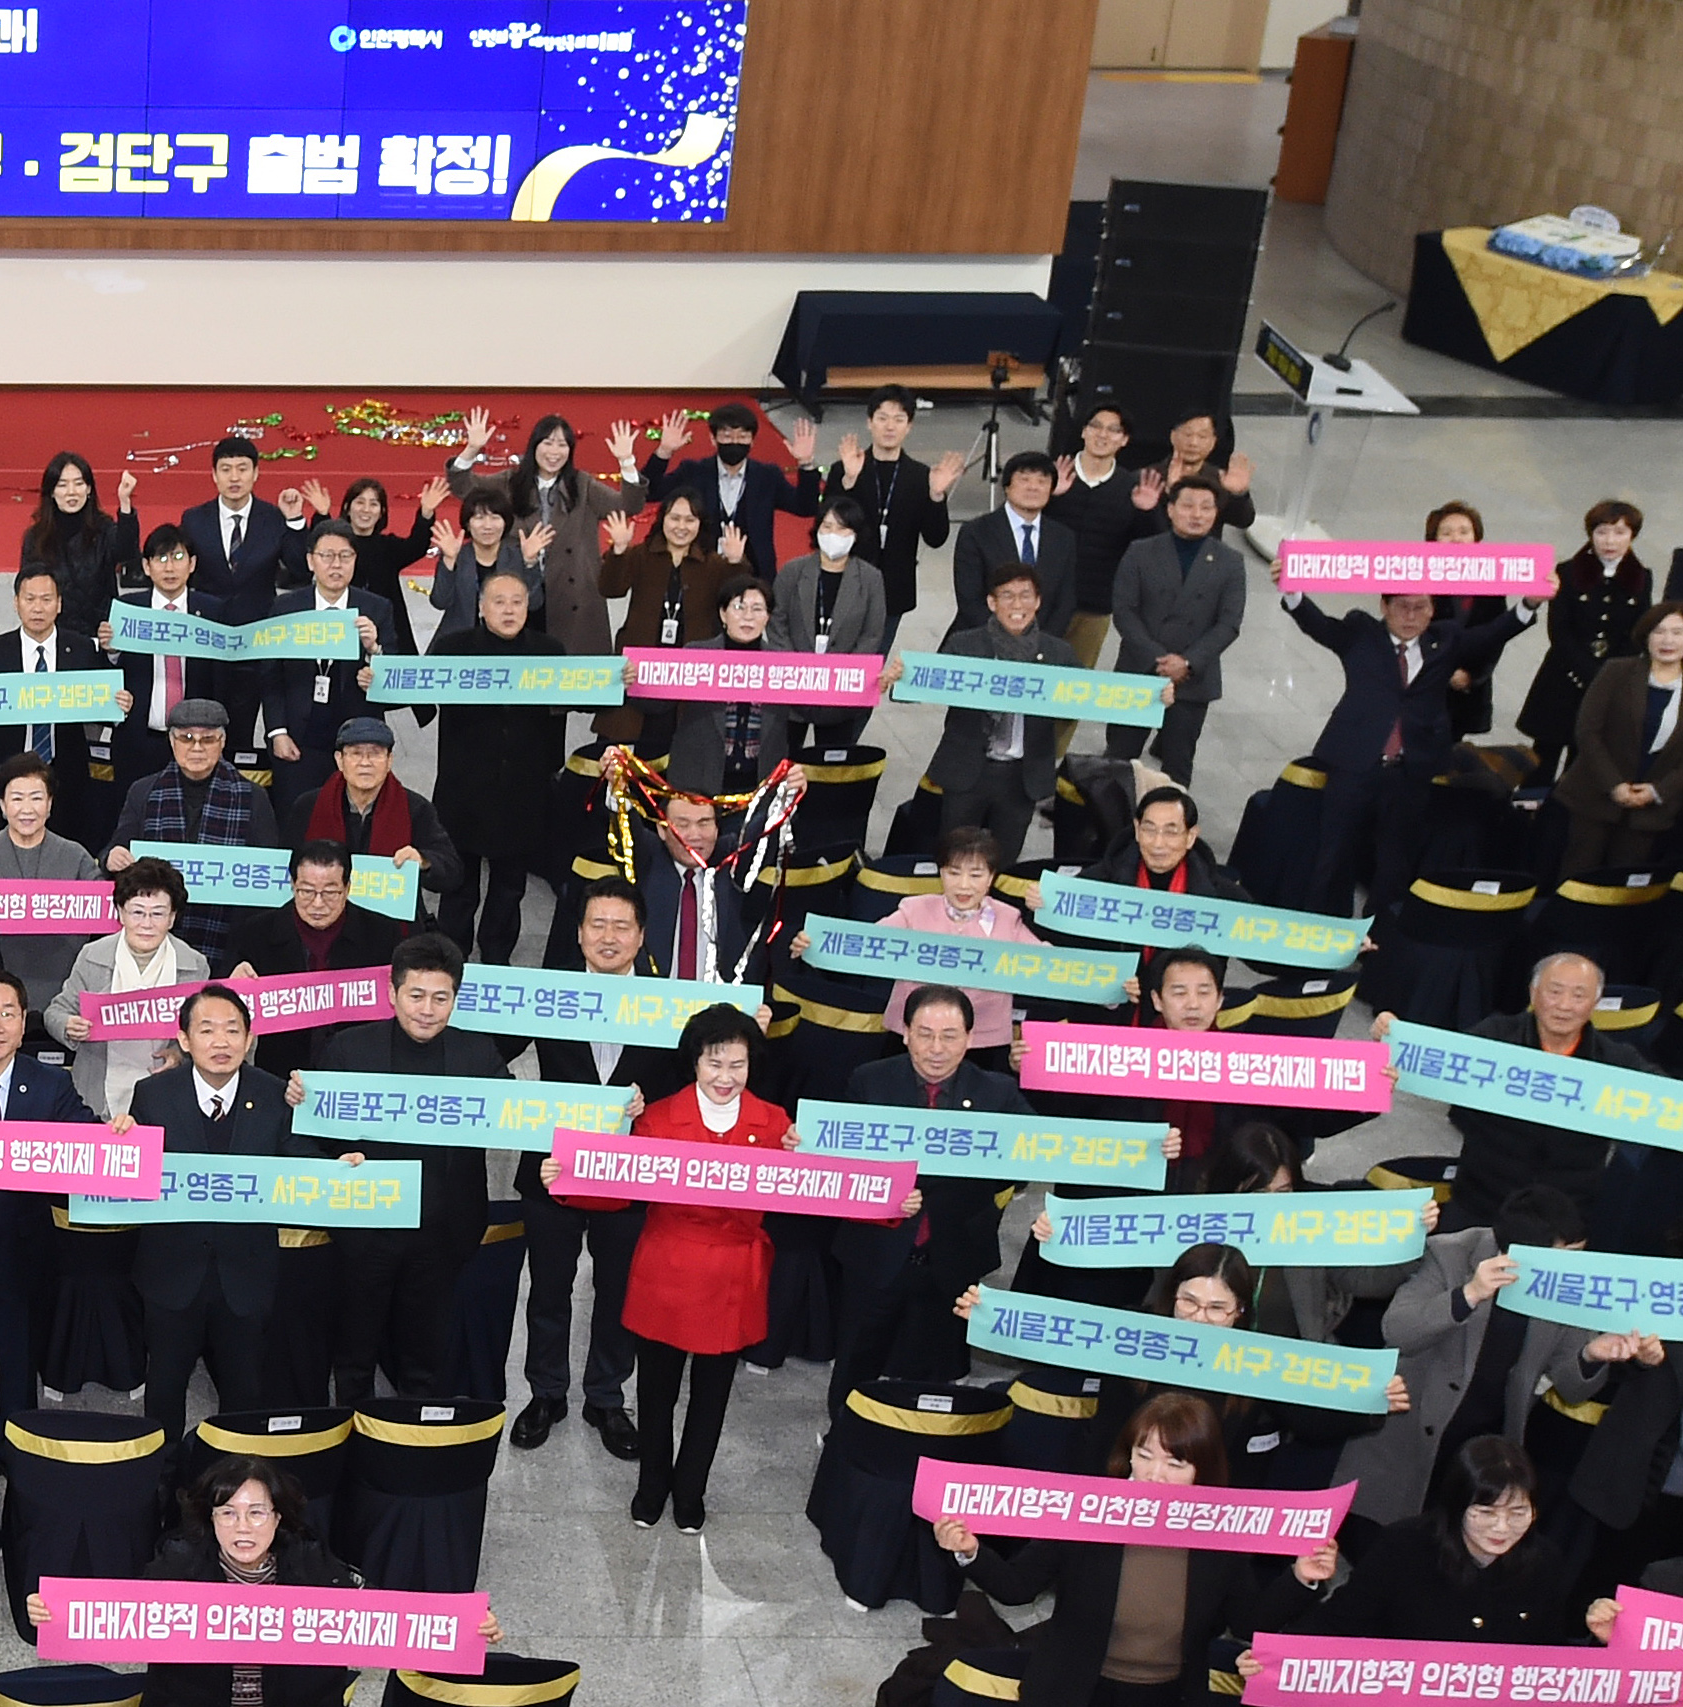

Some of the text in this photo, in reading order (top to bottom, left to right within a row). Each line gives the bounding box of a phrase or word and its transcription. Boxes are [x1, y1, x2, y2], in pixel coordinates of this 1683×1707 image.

[59, 132, 229, 194] 검단구
[246, 133, 361, 195] 출범
[378, 134, 512, 196] 확정!
[1287, 554, 1534, 582] 미래지향적 인천형 행정체제 개편
[252, 620, 347, 648] 서구·검단구
[518, 666, 612, 692] 서구·검단구
[639, 661, 864, 692] 미래지향적 인천형 행정체제 개편
[1052, 679, 1153, 710] 서구·검단구
[17, 681, 110, 712] 서구·검단구
[32, 894, 101, 919] 행정체제
[1229, 915, 1357, 955] 서구·검단구
[993, 951, 1119, 989] 서구·검단구
[259, 984, 333, 1017] 행정체제
[339, 980, 376, 1006] 개편
[1046, 1041, 1365, 1091] 미래지향적 인천형 행정체제 개편
[11, 1140, 95, 1175] 행정체제
[101, 1144, 140, 1178] 개편
[1009, 1131, 1149, 1169] 서구·검단구
[271, 1174, 403, 1211] 서구·검단구
[574, 1150, 892, 1203] 미래지향적 인천형 행정체제 개편
[1268, 1208, 1417, 1246] 서구·검단구
[1212, 1342, 1373, 1393] 서구·검단구
[942, 1483, 1332, 1538] 미래지향적 인천형 행정체제 개편
[68, 1602, 458, 1651] 미래지향적 인천형 행정체제 개편
[1279, 1659, 1682, 1704] 미래지향적 인천형 행정체제 개편
